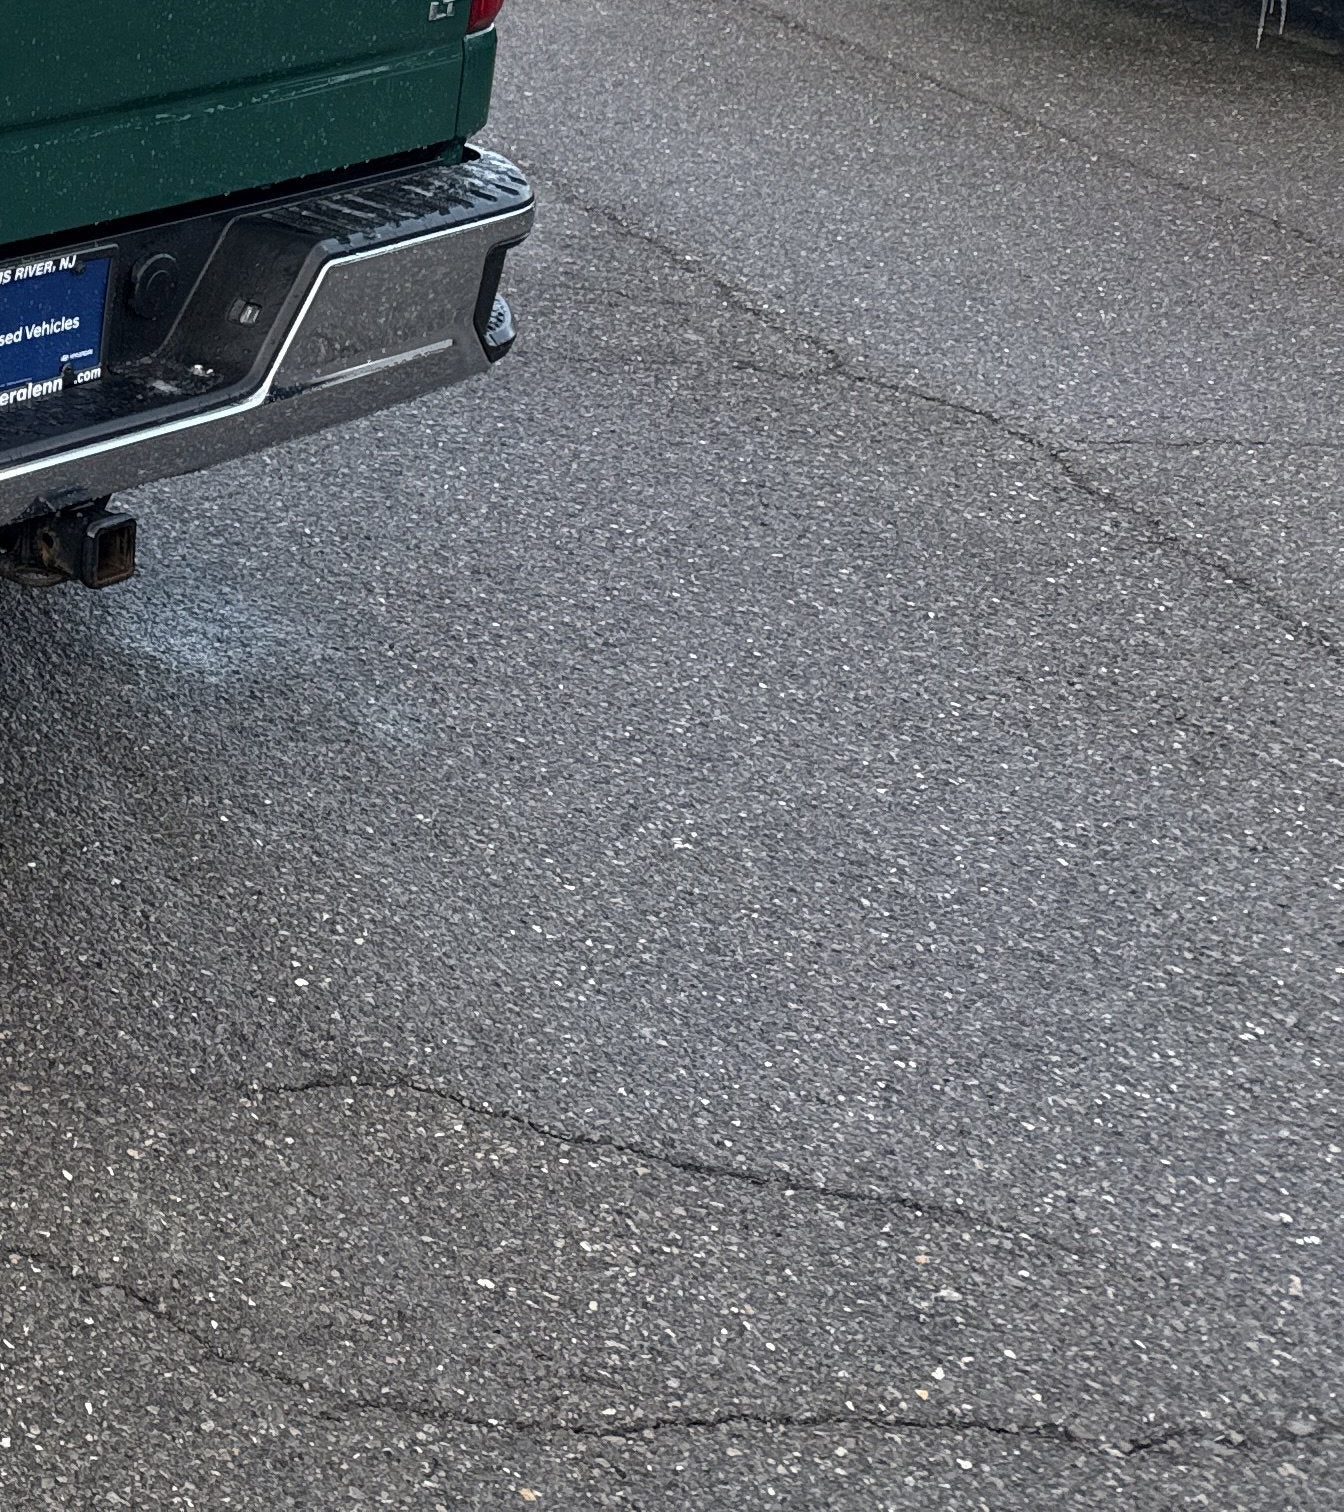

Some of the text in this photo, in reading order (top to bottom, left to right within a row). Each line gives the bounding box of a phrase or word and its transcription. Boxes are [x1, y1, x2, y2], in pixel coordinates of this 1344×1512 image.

[14, 260, 56, 282] RIVER,
[59, 255, 77, 271] NJ
[25, 316, 80, 340] Vehicles
